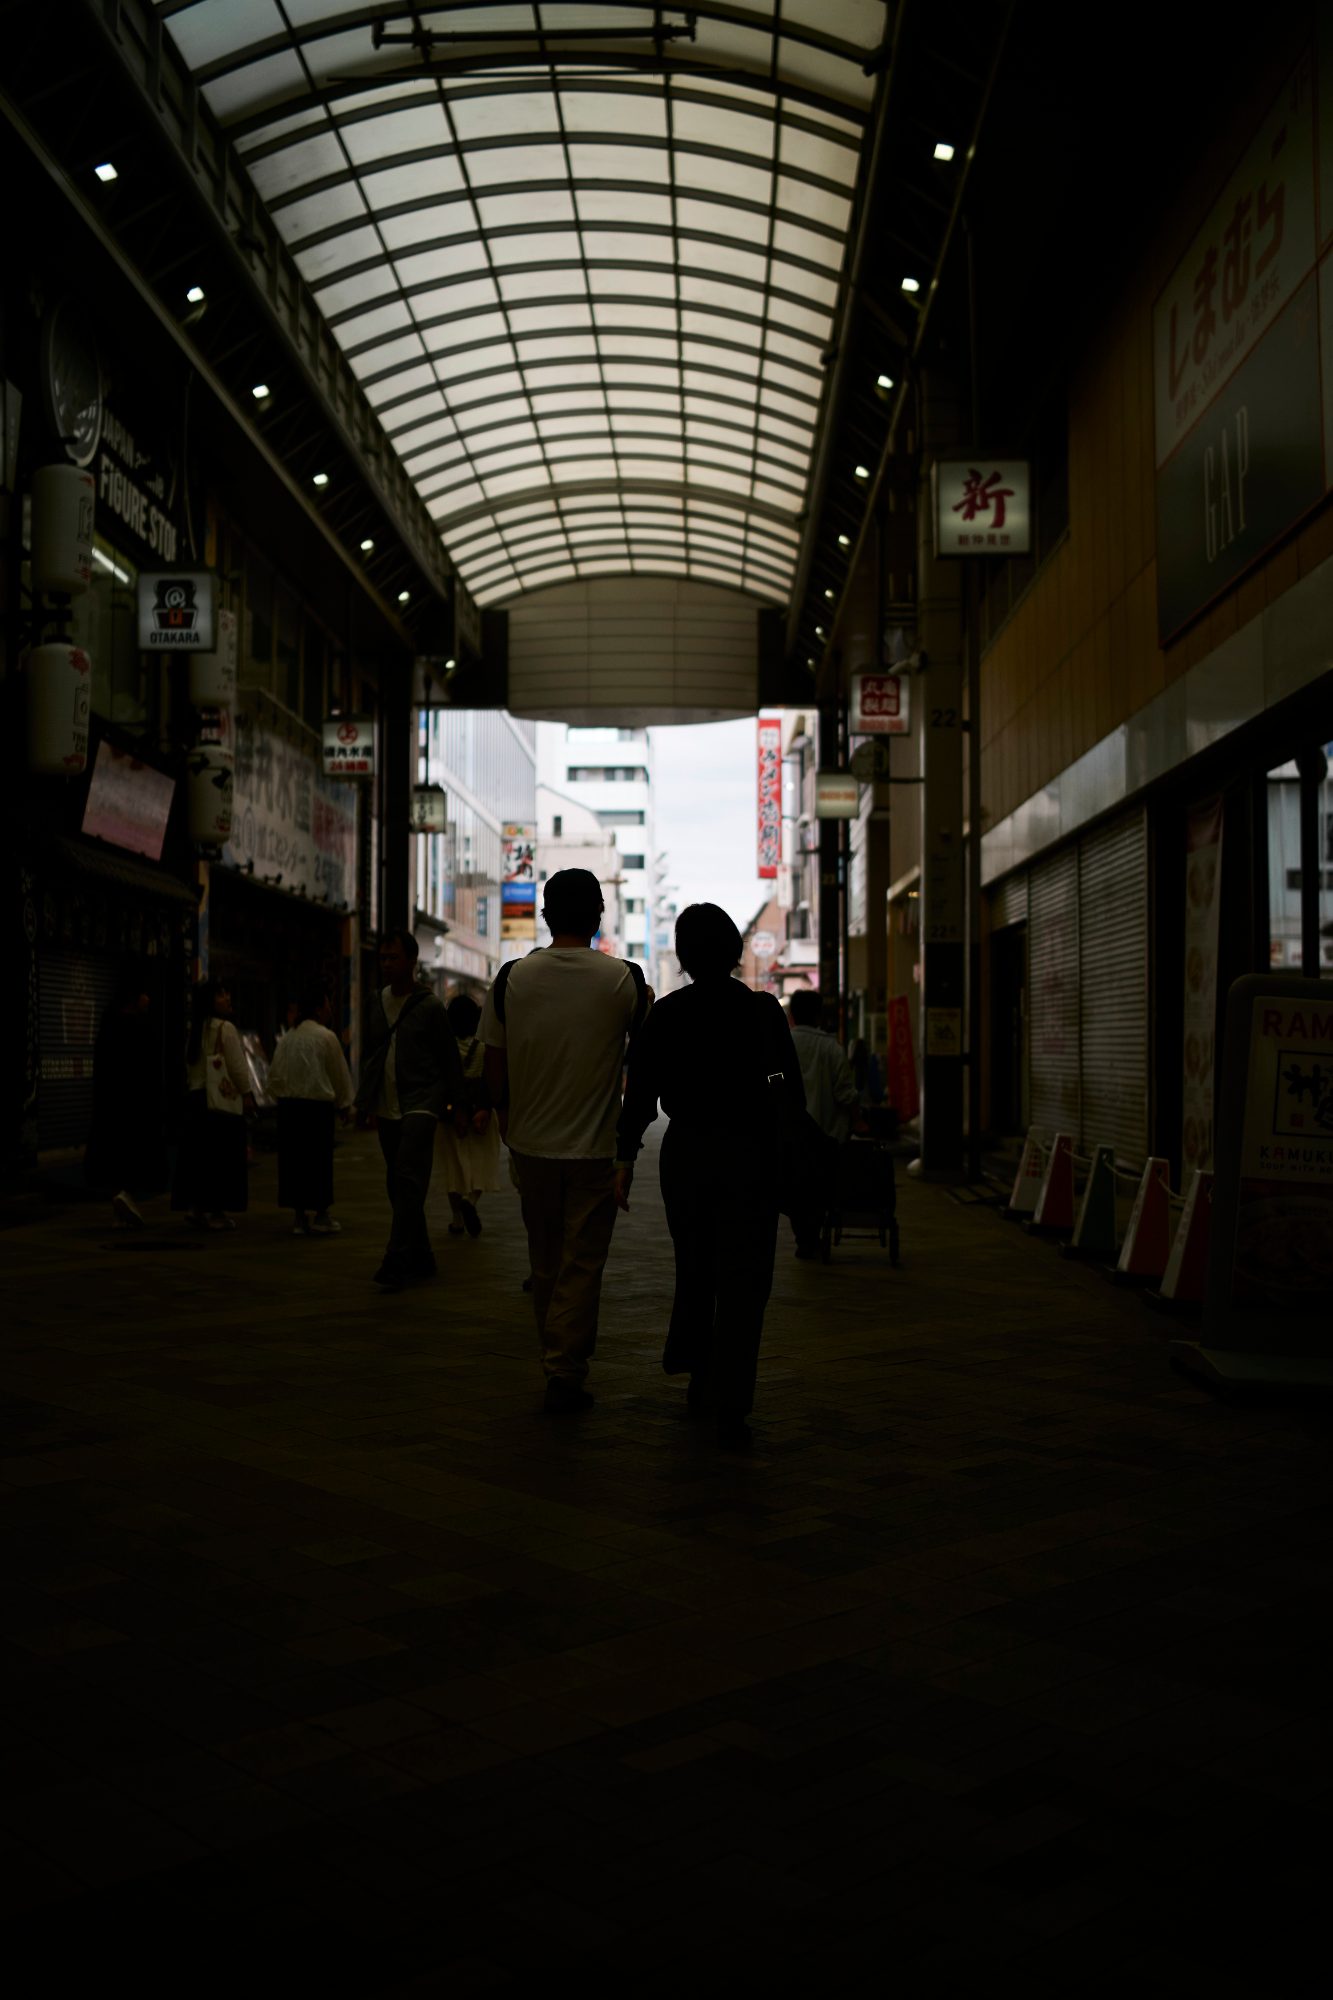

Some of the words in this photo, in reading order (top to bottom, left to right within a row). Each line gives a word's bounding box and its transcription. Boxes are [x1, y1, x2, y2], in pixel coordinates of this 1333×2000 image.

[1169, 181, 1285, 402] しまむら
[100, 452, 149, 541] FIGURE
[952, 468, 1015, 528] 新
[1204, 405, 1249, 563] GAP
[150, 630, 200, 644] OTAKARA
[931, 708, 957, 727] 22
